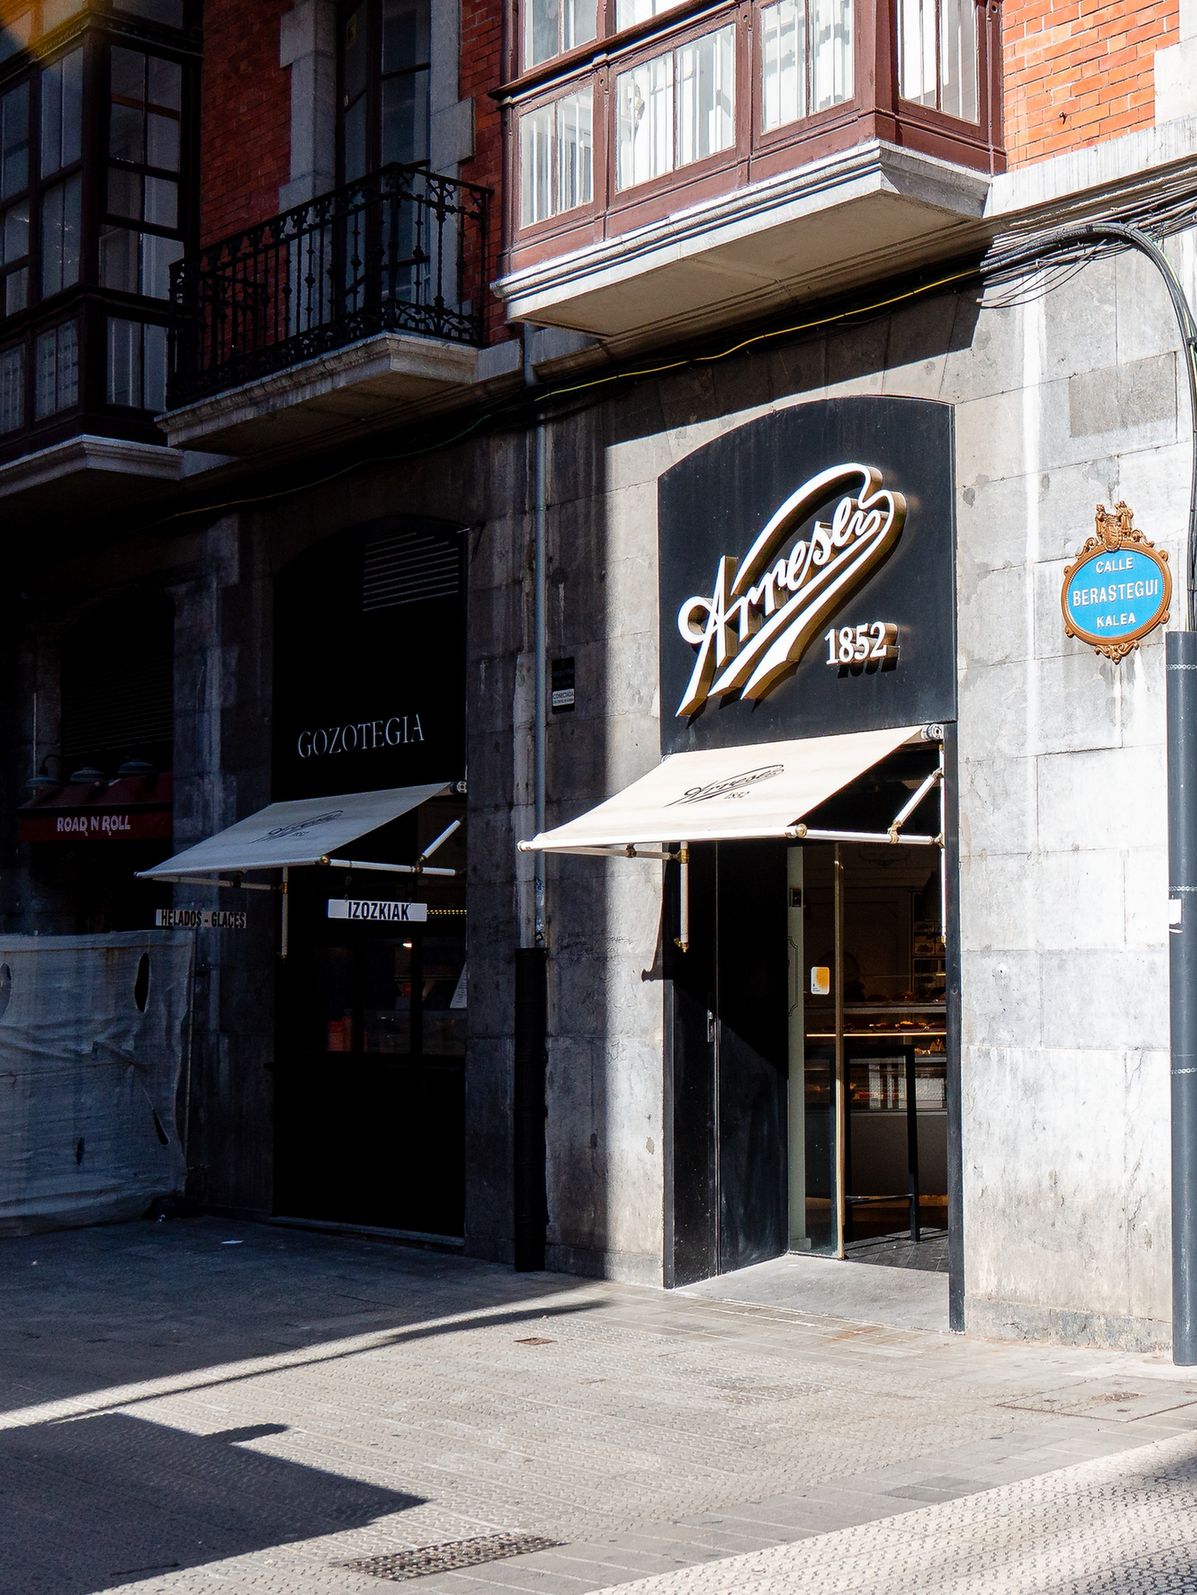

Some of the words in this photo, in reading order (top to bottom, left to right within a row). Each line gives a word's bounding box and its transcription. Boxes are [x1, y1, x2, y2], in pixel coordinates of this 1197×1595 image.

[1095, 557, 1134, 574] CALLE
[1073, 579, 1159, 607] BERASTEGUI
[1096, 612, 1137, 629] KALEA
[824, 621, 897, 666] 1852
[297, 713, 425, 759] GOZOTEGIA
[57, 816, 88, 837] ROAD
[90, 815, 100, 831] N
[101, 814, 131, 836] ROLL
[161, 909, 202, 927] HELADOS
[211, 911, 247, 928] GLACES
[347, 900, 410, 921] IZOZKIAK
